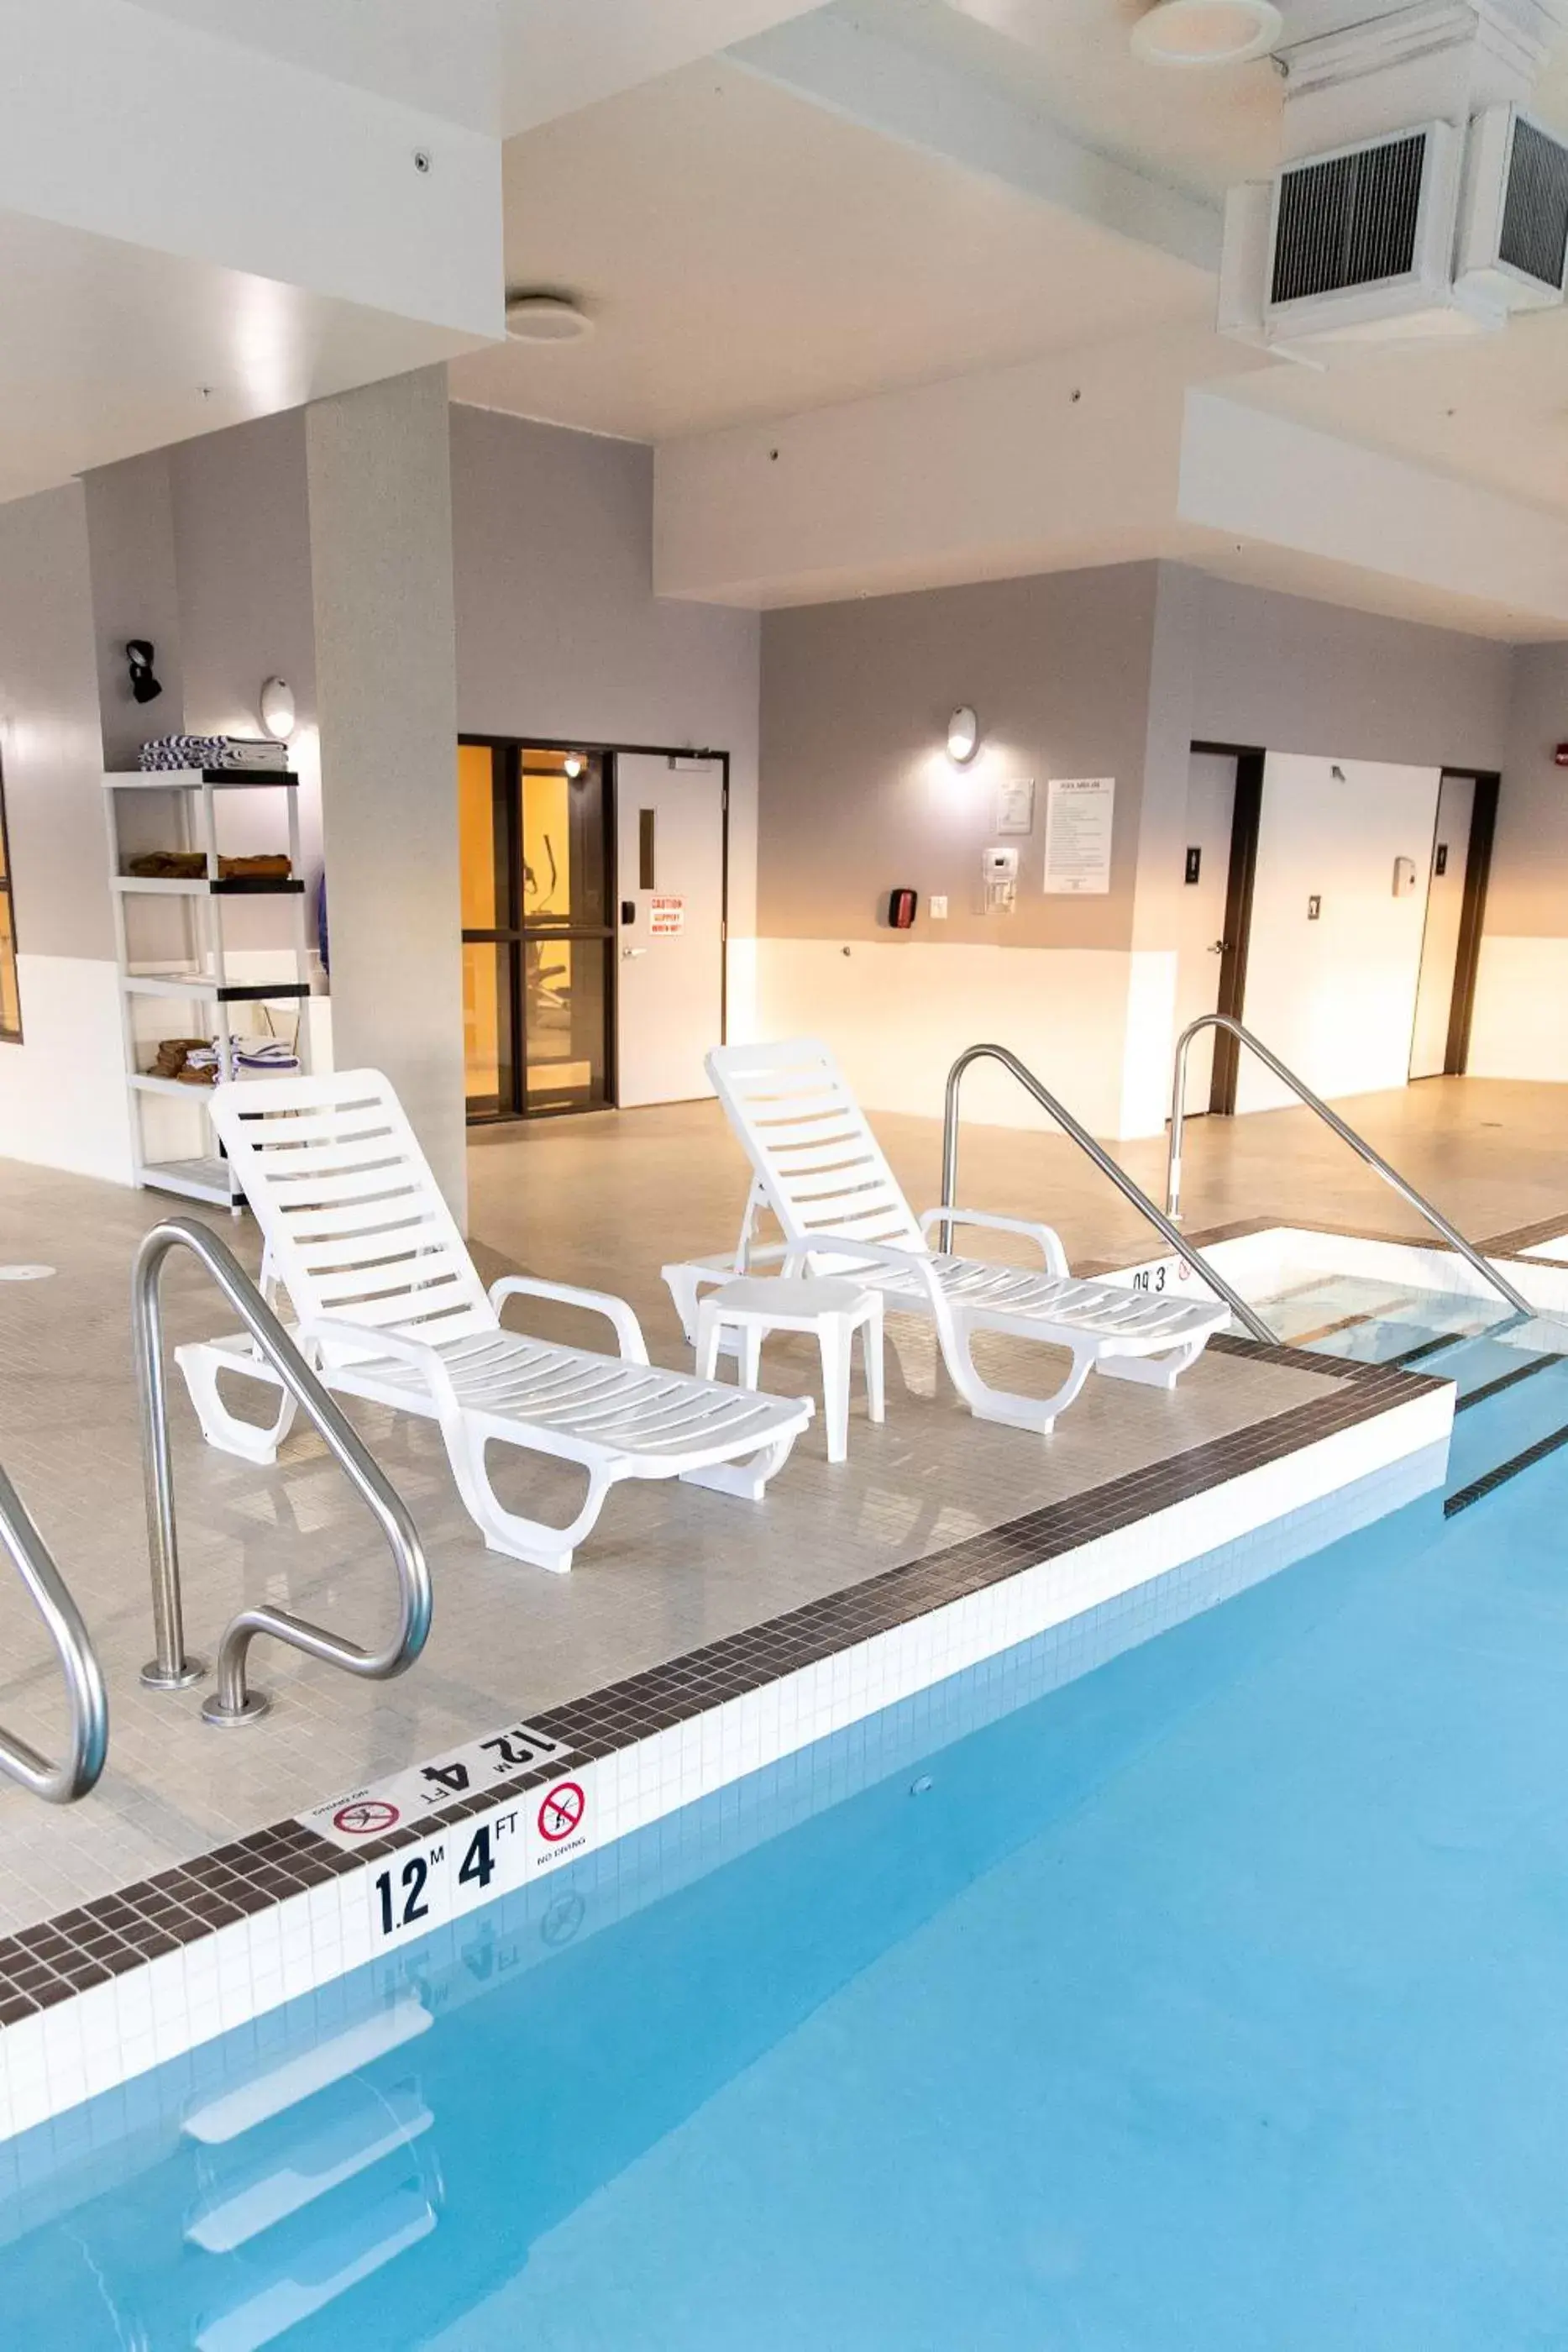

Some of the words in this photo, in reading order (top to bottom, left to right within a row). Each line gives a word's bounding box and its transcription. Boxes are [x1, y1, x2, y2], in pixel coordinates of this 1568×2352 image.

[652, 898, 682, 909] CAUTION
[1156, 1266, 1166, 1292] 3
[420, 1762, 469, 1791] 4
[421, 1787, 451, 1805] FT
[538, 1852, 553, 1866] NO
[554, 1836, 586, 1857] DIVING
[375, 1856, 429, 1935] 1.2
[430, 1845, 445, 1866] M
[459, 1824, 496, 1889] 4
[495, 1810, 518, 1840] FT
